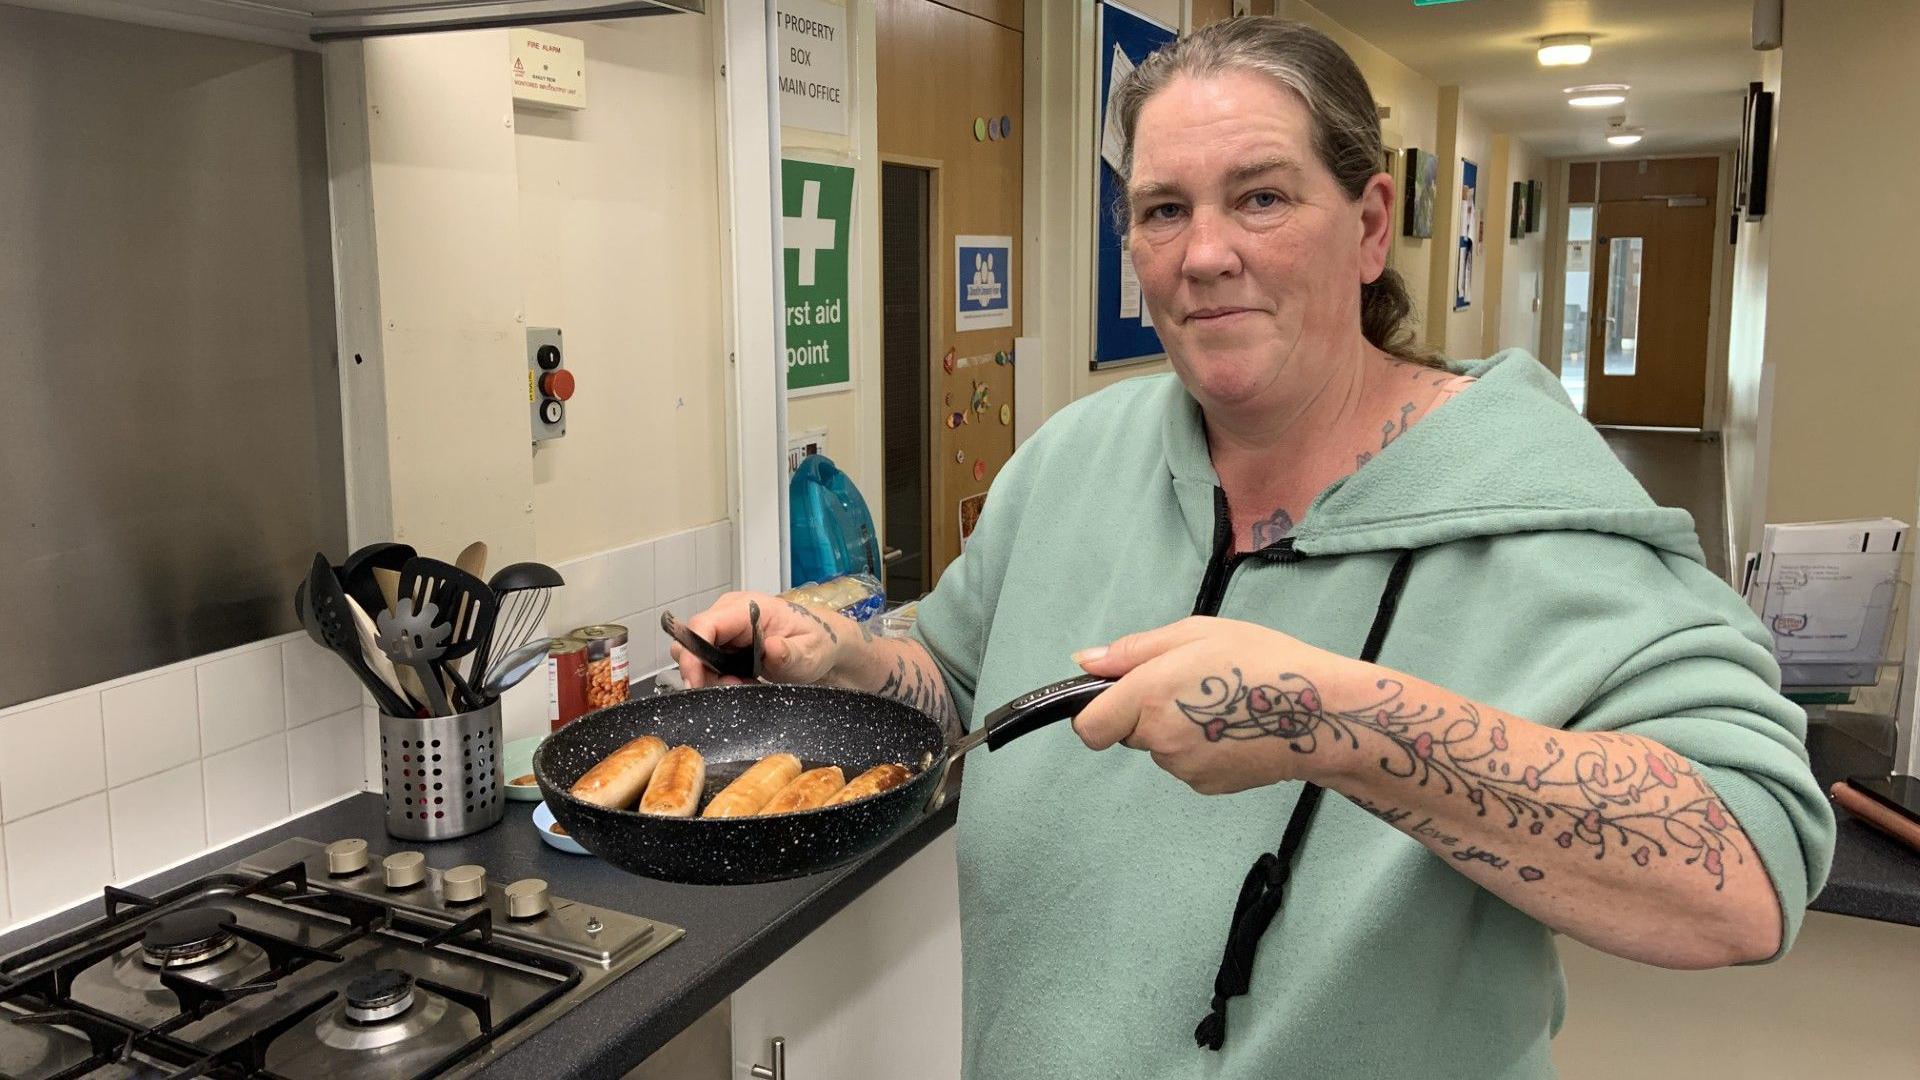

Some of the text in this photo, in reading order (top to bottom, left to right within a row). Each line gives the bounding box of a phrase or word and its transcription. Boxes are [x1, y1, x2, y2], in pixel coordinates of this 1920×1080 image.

[784, 14, 835, 42] PROPERTY
[527, 40, 561, 54] FIRE ALARM
[790, 47, 811, 67] BOX
[779, 75, 841, 104] MAIN OFFICE
[815, 298, 841, 325] aid
[785, 339, 830, 373] point
[1411, 817, 1459, 847] love
[1452, 846, 1510, 870] you
